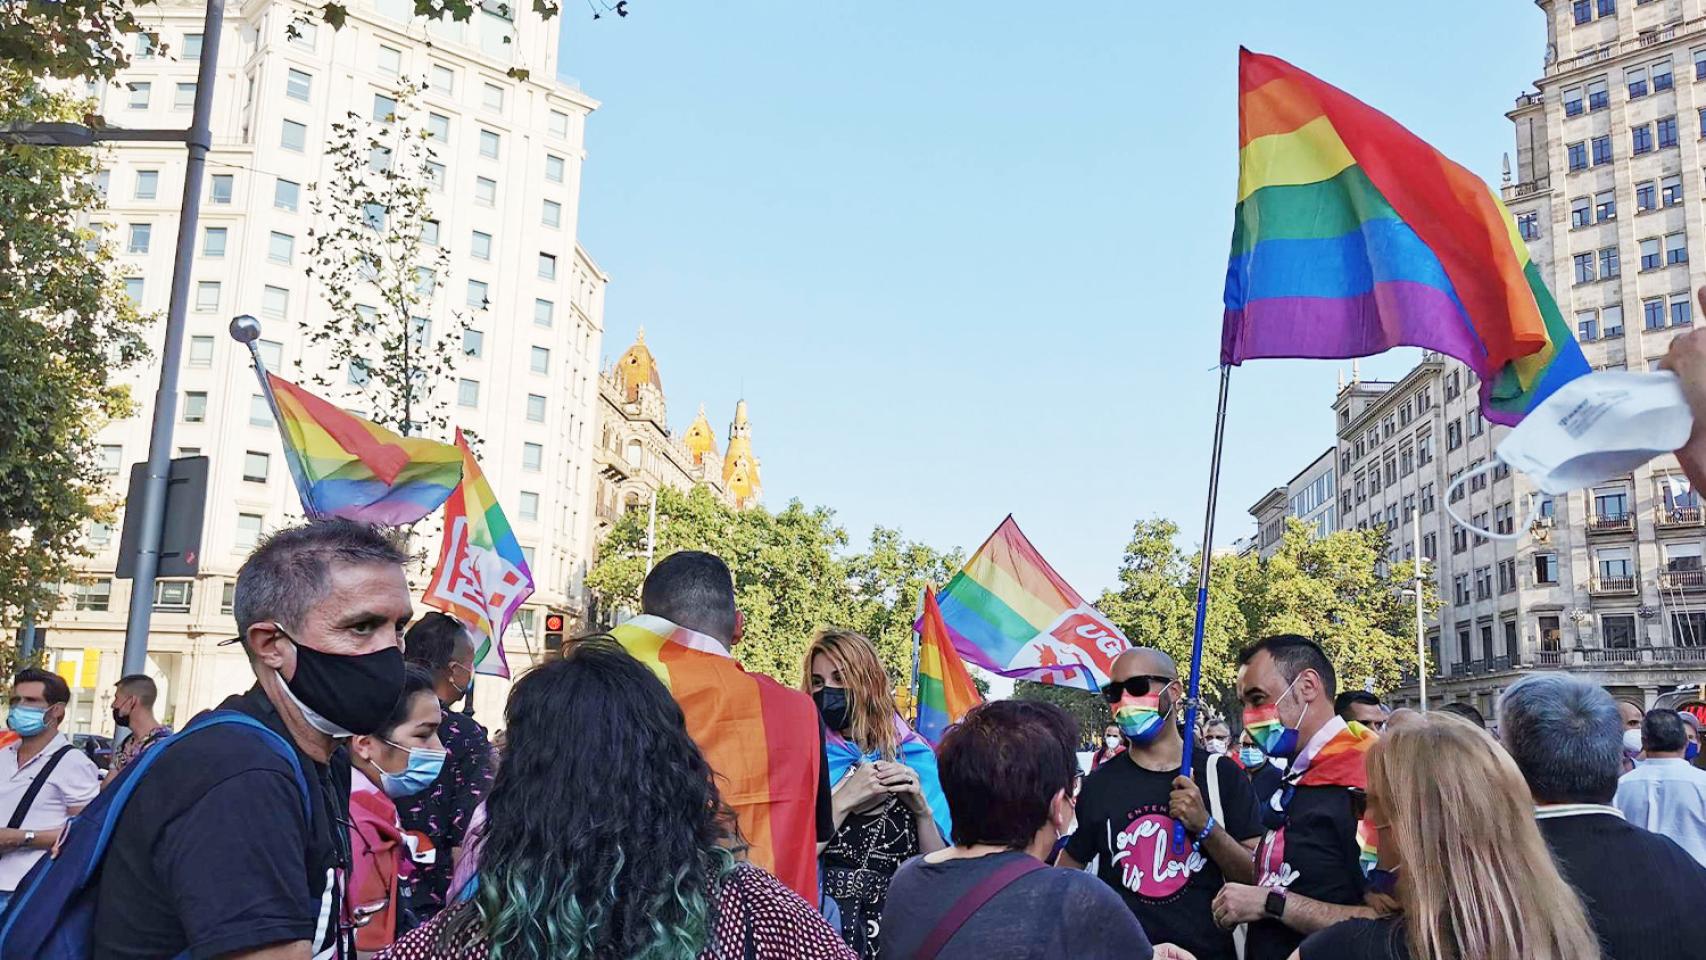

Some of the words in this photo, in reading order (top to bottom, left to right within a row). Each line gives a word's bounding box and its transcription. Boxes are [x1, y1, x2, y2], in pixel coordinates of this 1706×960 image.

[1075, 623, 1121, 659] UG
[1153, 828, 1207, 883] love
[1122, 863, 1144, 892] is
